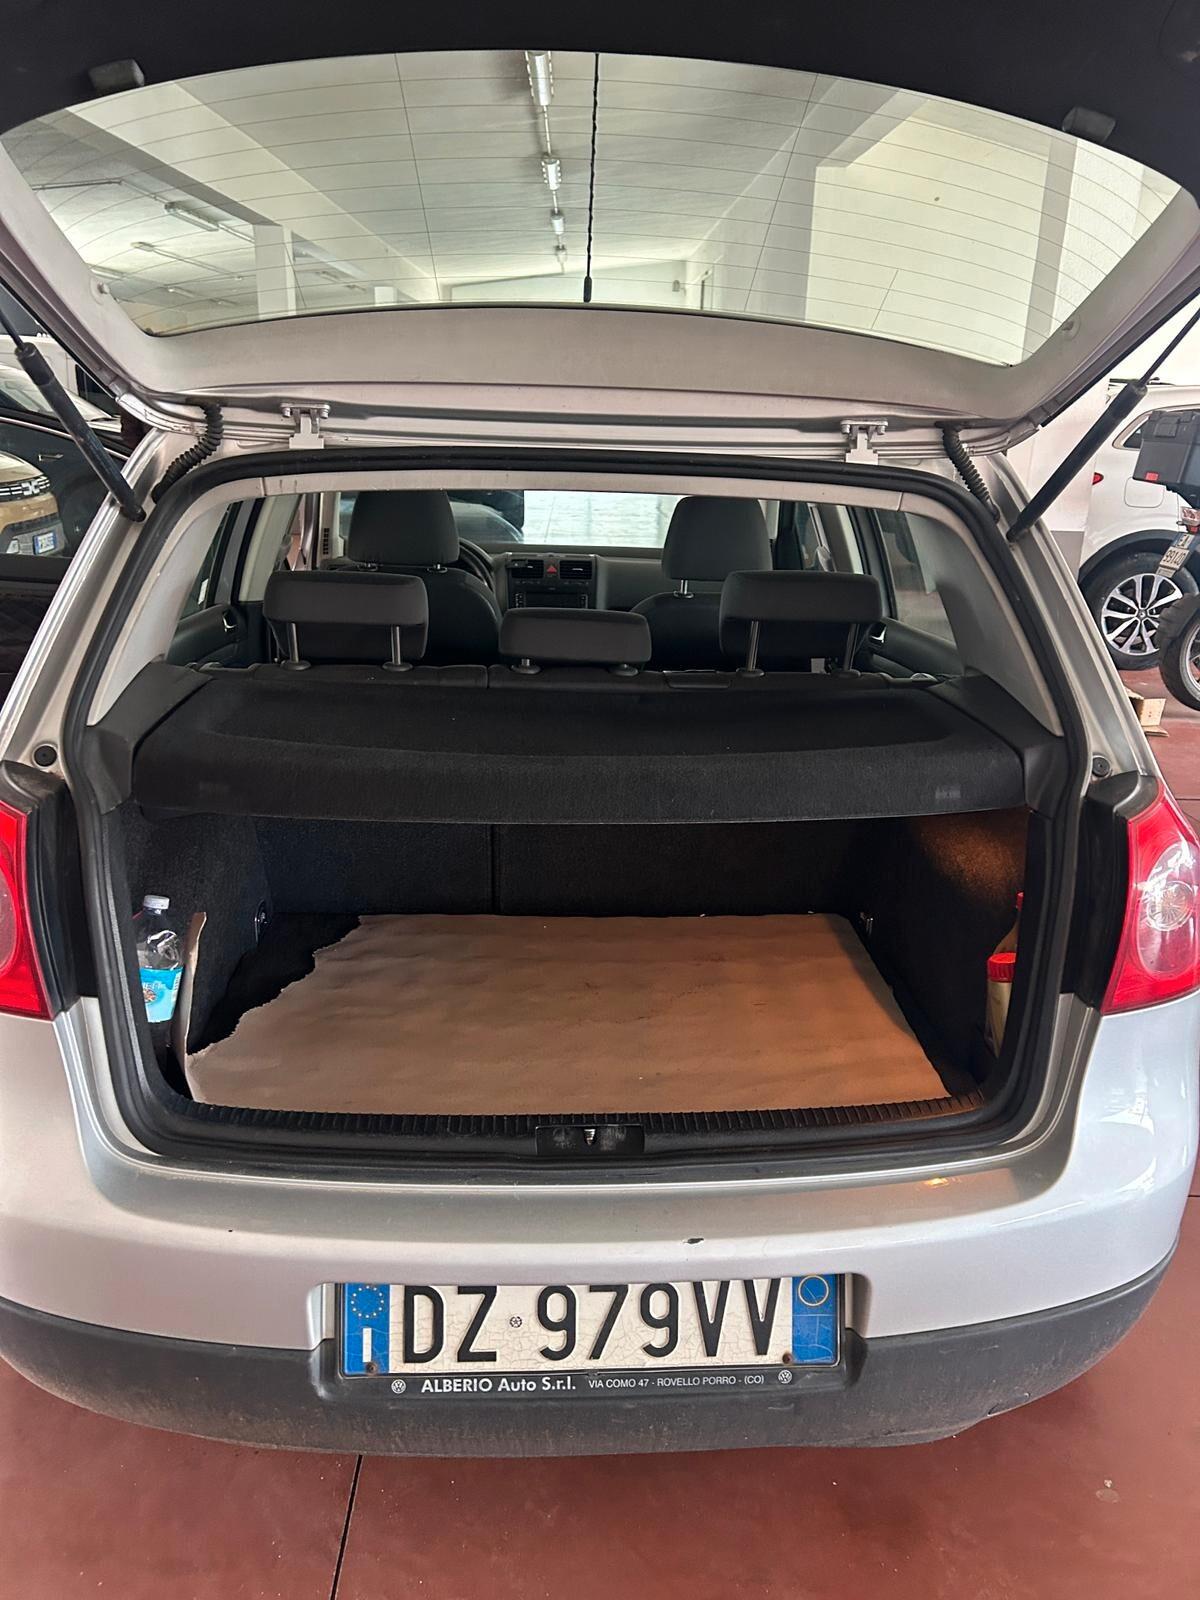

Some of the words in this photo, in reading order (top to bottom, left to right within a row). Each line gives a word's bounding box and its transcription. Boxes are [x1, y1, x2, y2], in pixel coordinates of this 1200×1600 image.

[362, 1327, 373, 1363] I
[403, 1285, 498, 1364] DZ
[537, 1278, 782, 1361] 979VV
[421, 1378, 493, 1393] ALBERIO
[497, 1377, 537, 1392] Auto
[541, 1375, 576, 1391] S.r.l.
[588, 1379, 604, 1388] VIA
[606, 1379, 637, 1388] COMO
[638, 1378, 650, 1387] 47
[657, 1377, 700, 1387] ROVELLO
[702, 1376, 736, 1385] PORRO
[744, 1375, 765, 1385] (CO)
